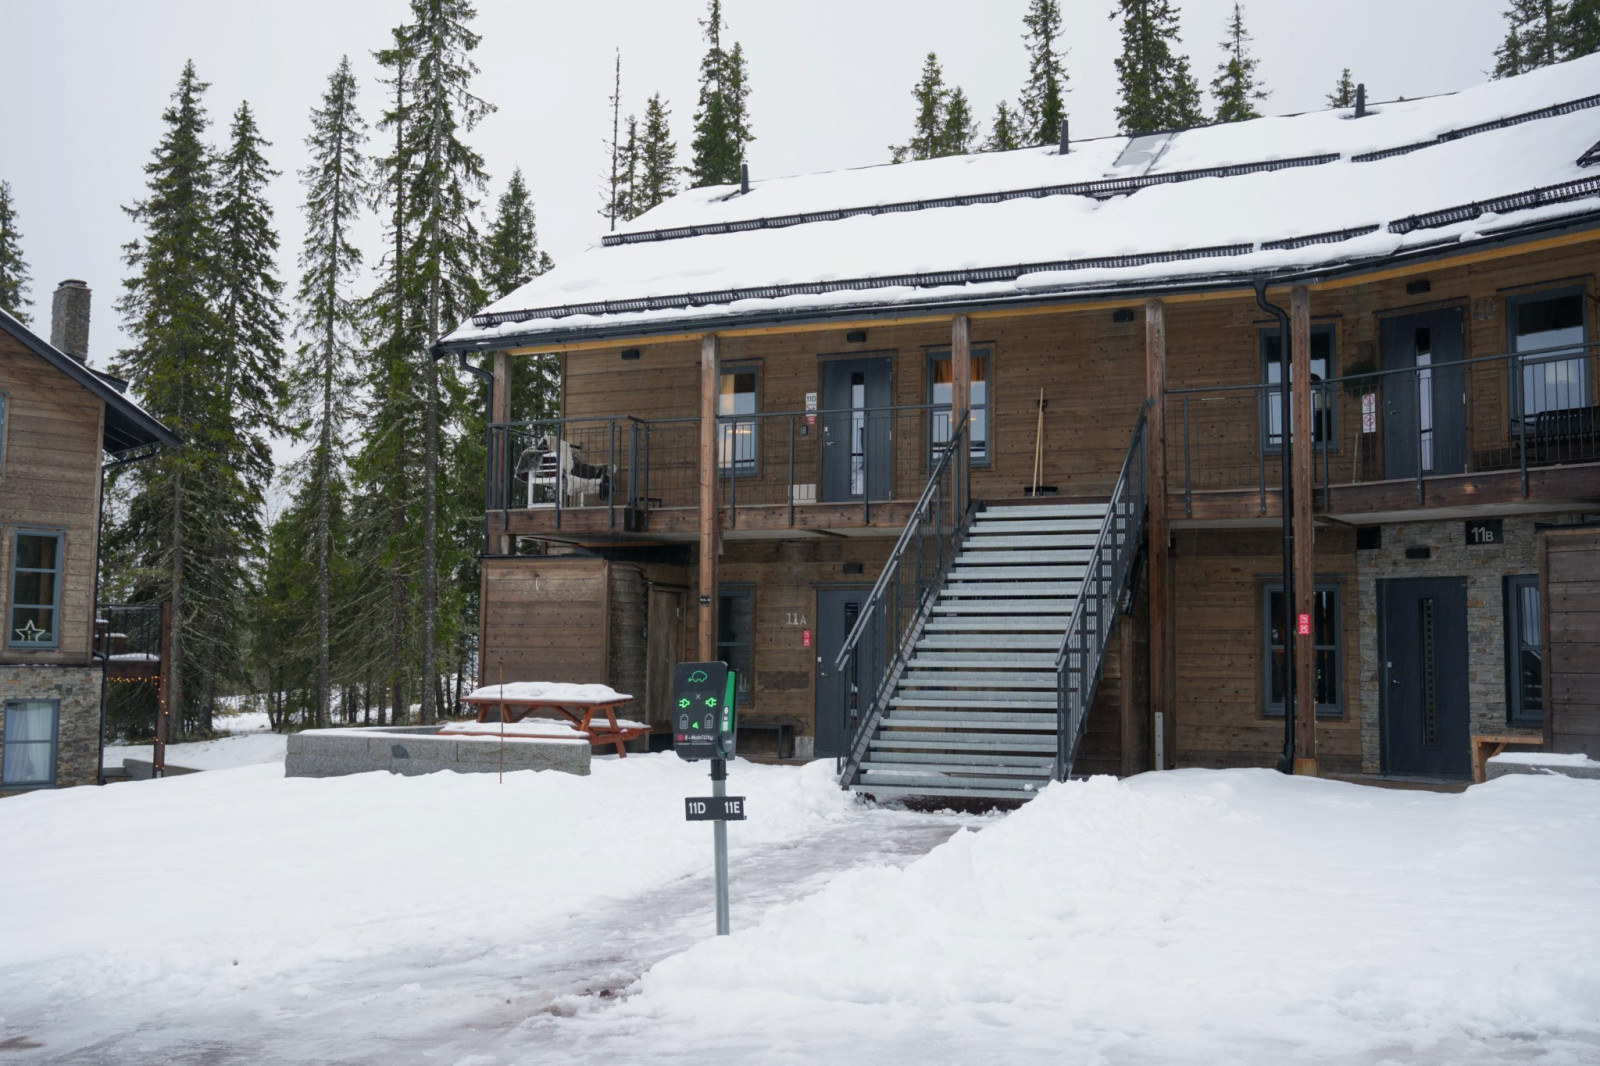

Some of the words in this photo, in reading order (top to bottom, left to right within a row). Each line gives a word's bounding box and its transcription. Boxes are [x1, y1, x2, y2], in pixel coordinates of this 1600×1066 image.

[806, 395, 817, 403] 11D
[1471, 526, 1494, 542] 11B
[785, 612, 807, 625] 11A
[689, 802, 706, 814] 11D
[724, 801, 741, 814] 11E
